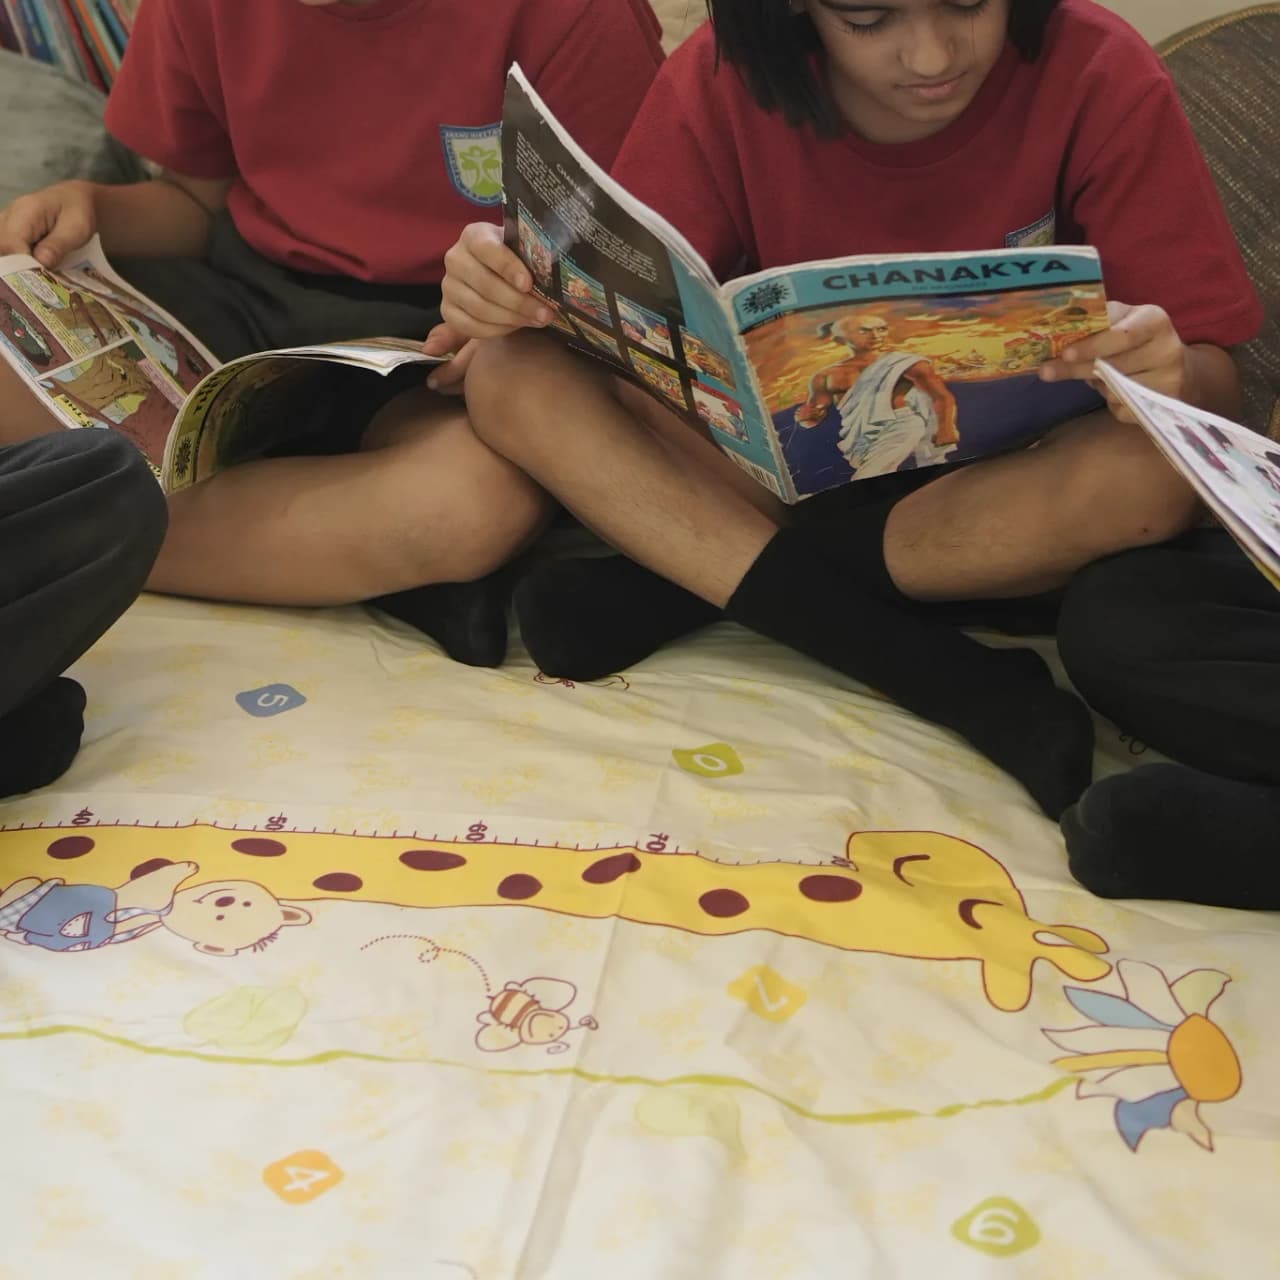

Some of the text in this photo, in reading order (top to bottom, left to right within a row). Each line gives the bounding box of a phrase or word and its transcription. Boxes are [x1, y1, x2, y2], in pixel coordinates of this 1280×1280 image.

[822, 259, 1072, 290] CHANAKYA
[71, 808, 95, 826] 40
[264, 815, 288, 831] 50
[465, 823, 488, 842] 60
[646, 832, 670, 851] 70
[281, 1166, 330, 1193] 4
